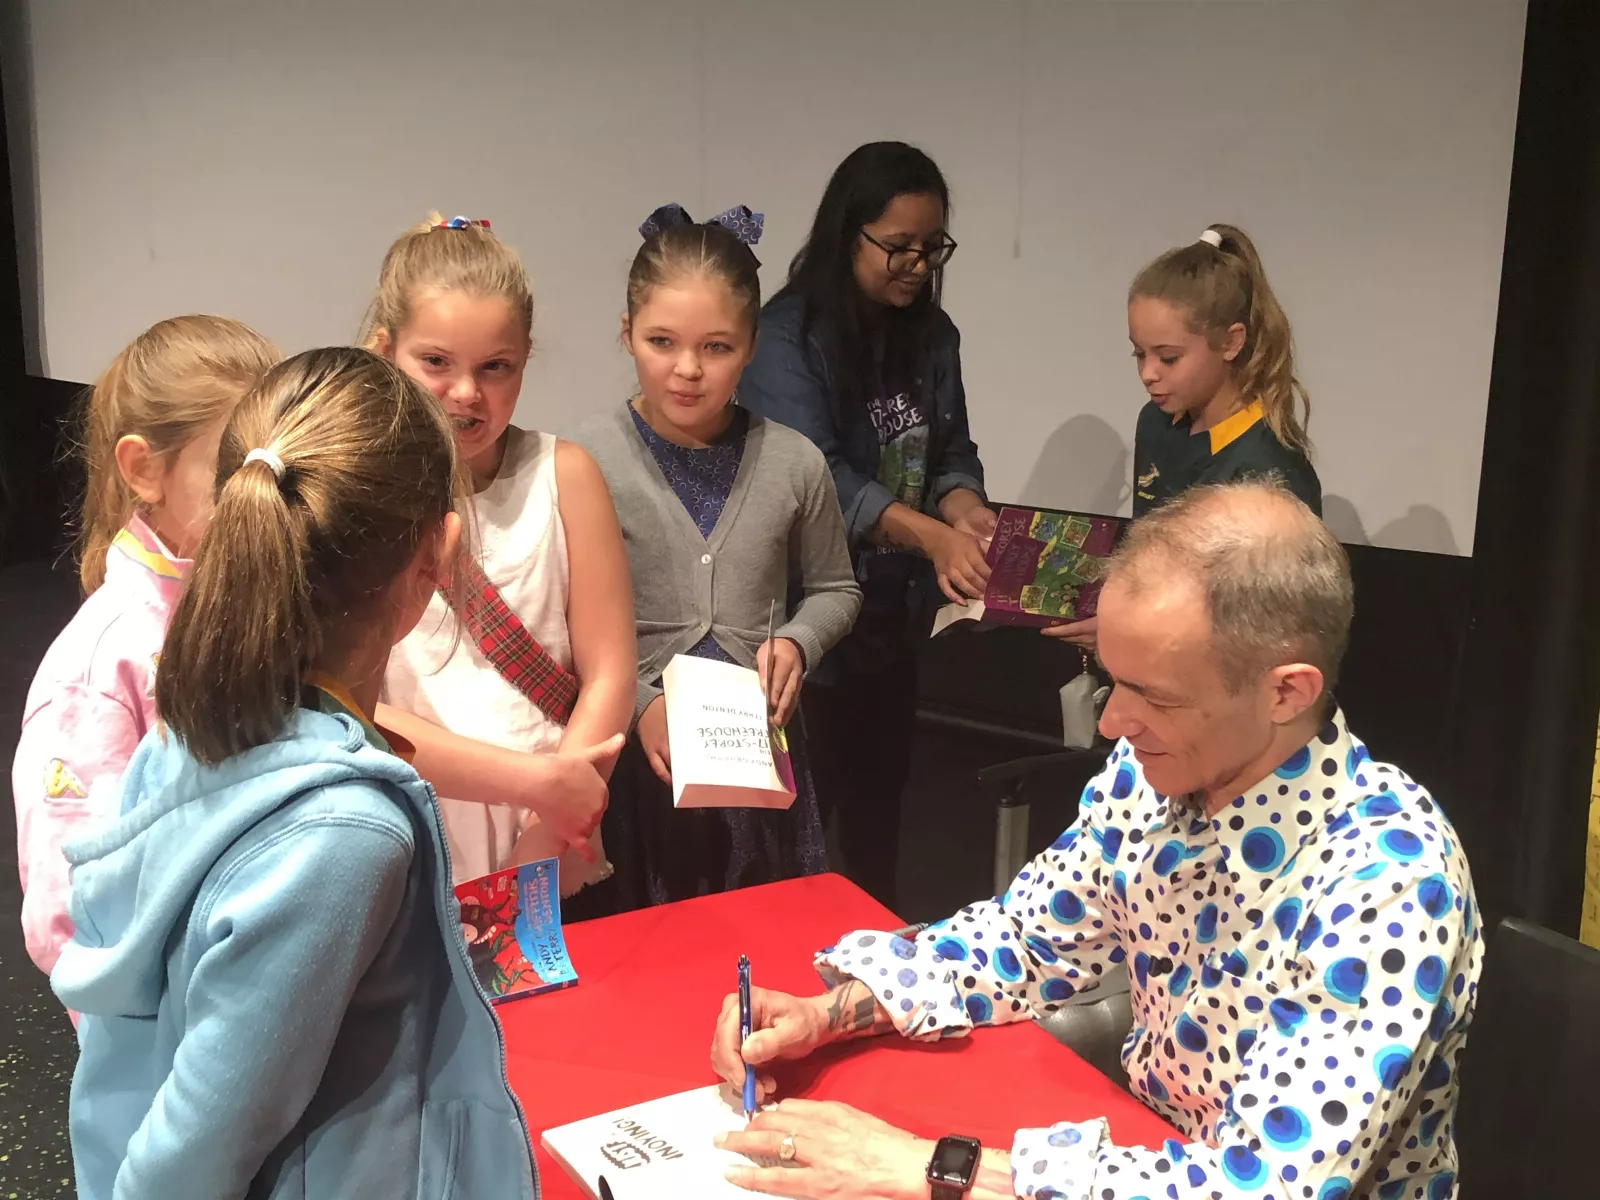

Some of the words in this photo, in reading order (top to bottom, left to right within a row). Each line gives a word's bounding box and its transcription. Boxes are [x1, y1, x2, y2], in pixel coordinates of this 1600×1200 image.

[702, 704, 736, 715] DENTON
[704, 738, 768, 749] 17-STOREY
[539, 943, 557, 972] ANDY
